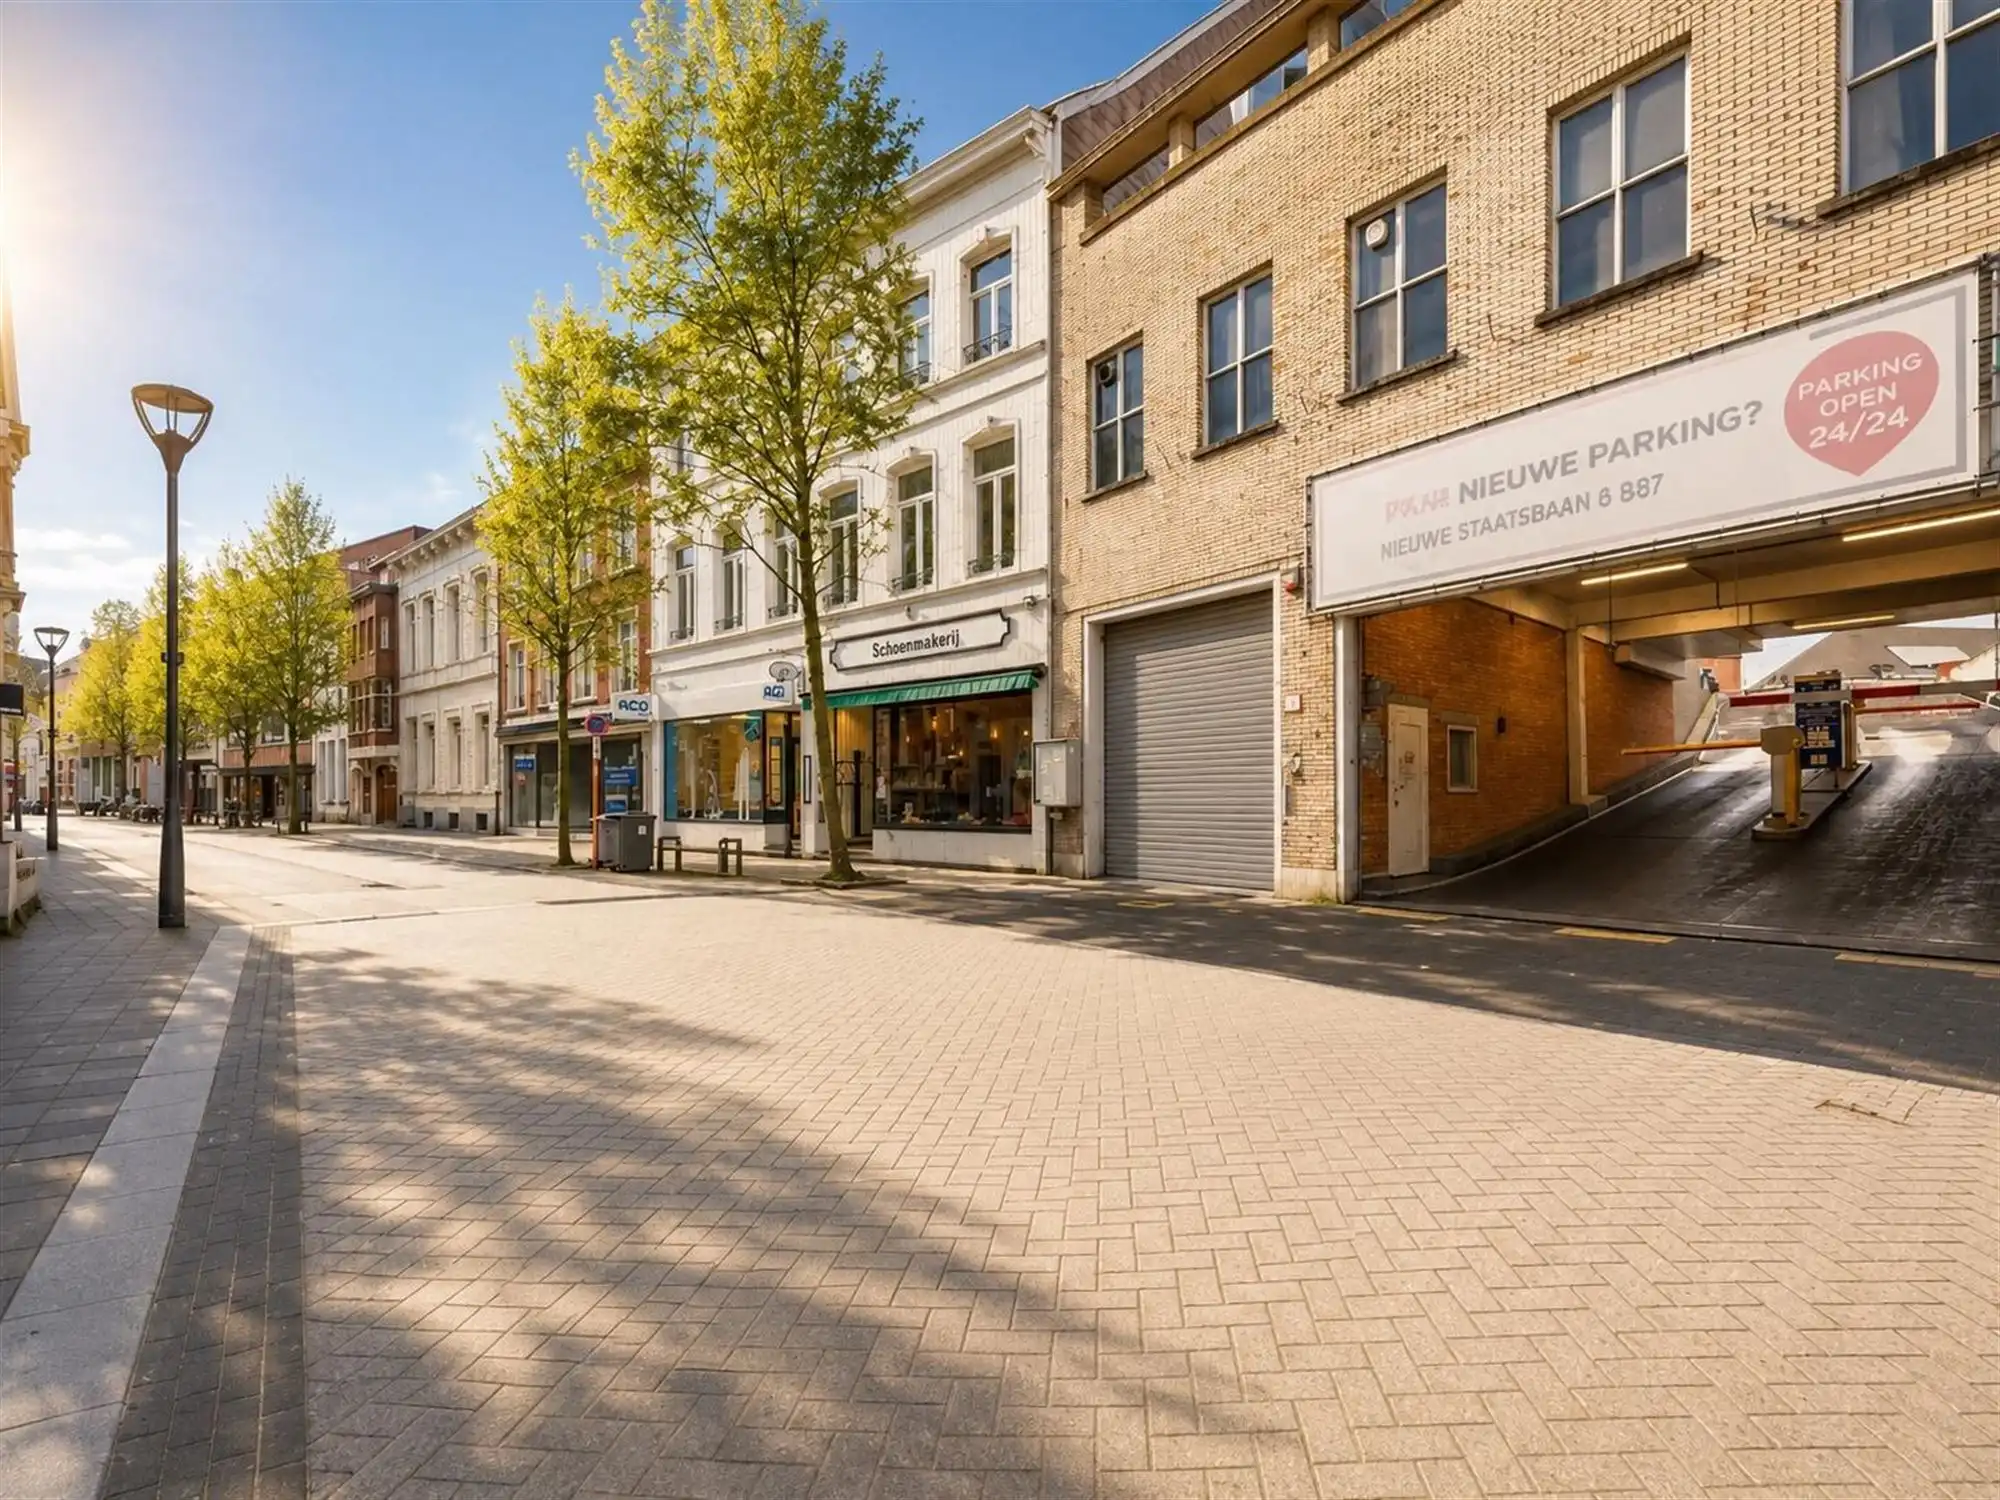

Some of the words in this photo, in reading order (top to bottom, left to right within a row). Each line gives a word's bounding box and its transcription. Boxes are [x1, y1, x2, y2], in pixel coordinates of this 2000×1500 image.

[1798, 352, 1923, 401] PARKING
[1819, 381, 1897, 417] OPEN
[1808, 405, 1910, 450] 24/24
[1458, 449, 1578, 505] NIEUWE
[1588, 400, 1763, 469] PARKING?
[1381, 525, 1452, 561] NIEUWE
[1458, 491, 1591, 541] STAATSBAAN
[872, 628, 960, 658] Schoenmakerij
